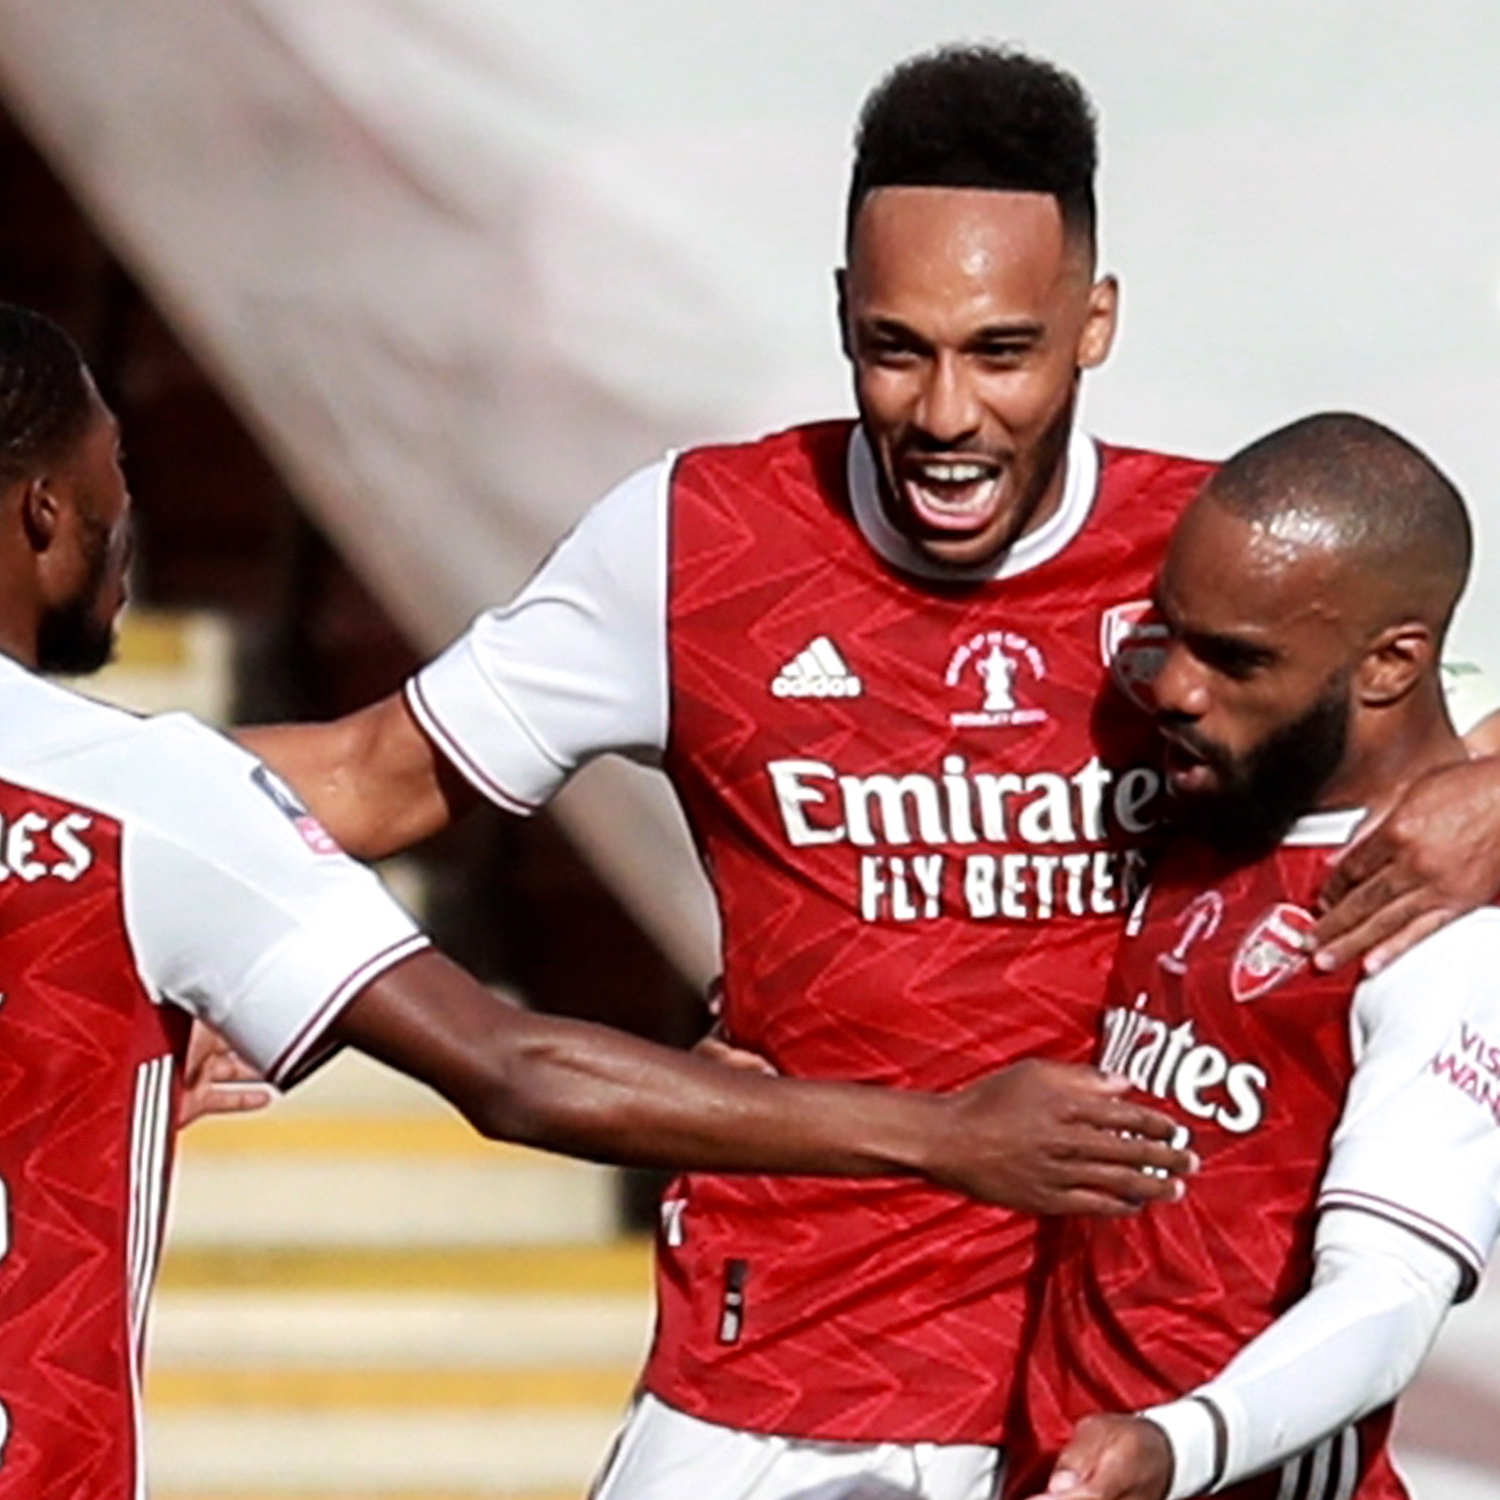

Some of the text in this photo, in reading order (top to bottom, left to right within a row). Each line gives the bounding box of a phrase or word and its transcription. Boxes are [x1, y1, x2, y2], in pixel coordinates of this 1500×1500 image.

[767, 755, 1176, 847] Emirate
[861, 853, 943, 921] FLY
[1101, 992, 1267, 1133] irates
